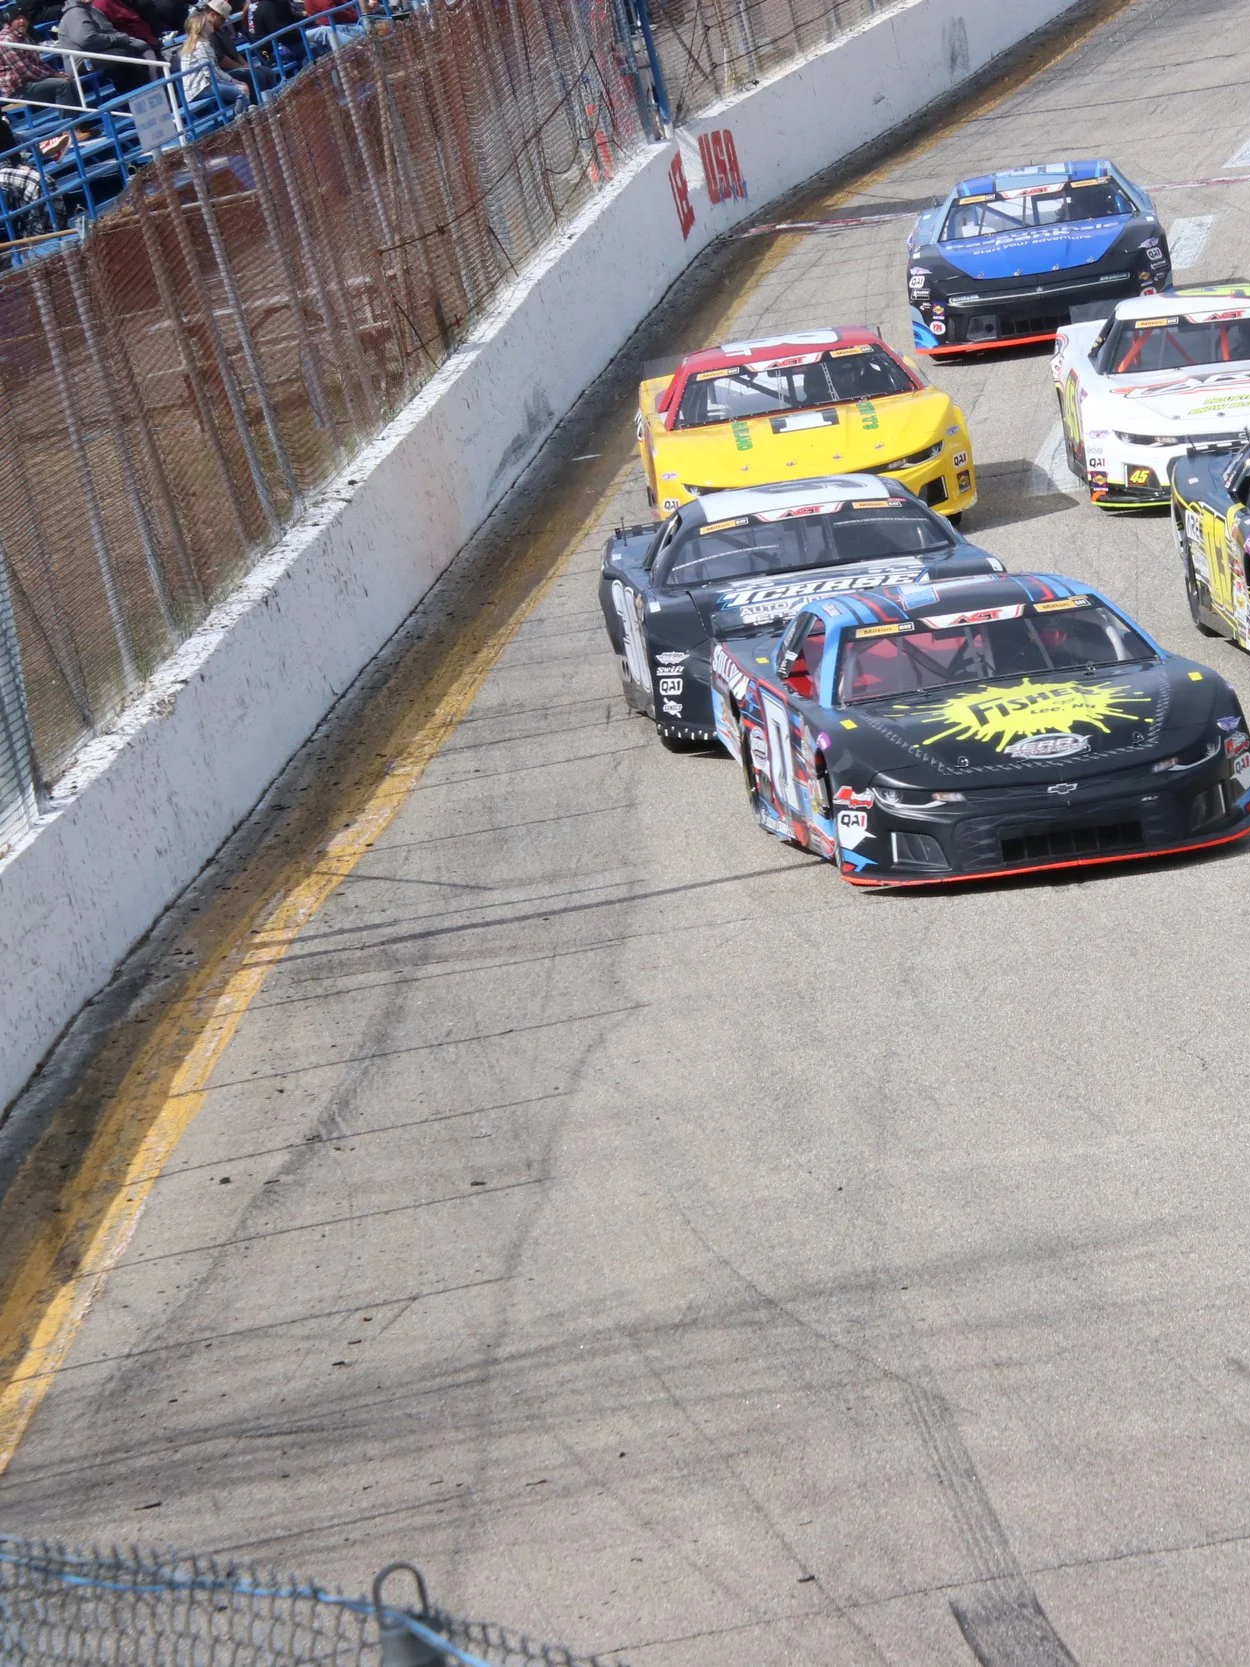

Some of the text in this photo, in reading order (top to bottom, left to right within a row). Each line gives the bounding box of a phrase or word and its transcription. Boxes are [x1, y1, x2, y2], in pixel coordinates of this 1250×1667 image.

[698, 129, 746, 204] USA
[1130, 469, 1150, 484] 45
[740, 602, 788, 617] AUTO
[949, 609, 1003, 625] ACT
[657, 665, 685, 675] Swift
[968, 686, 1101, 727] FISHER
